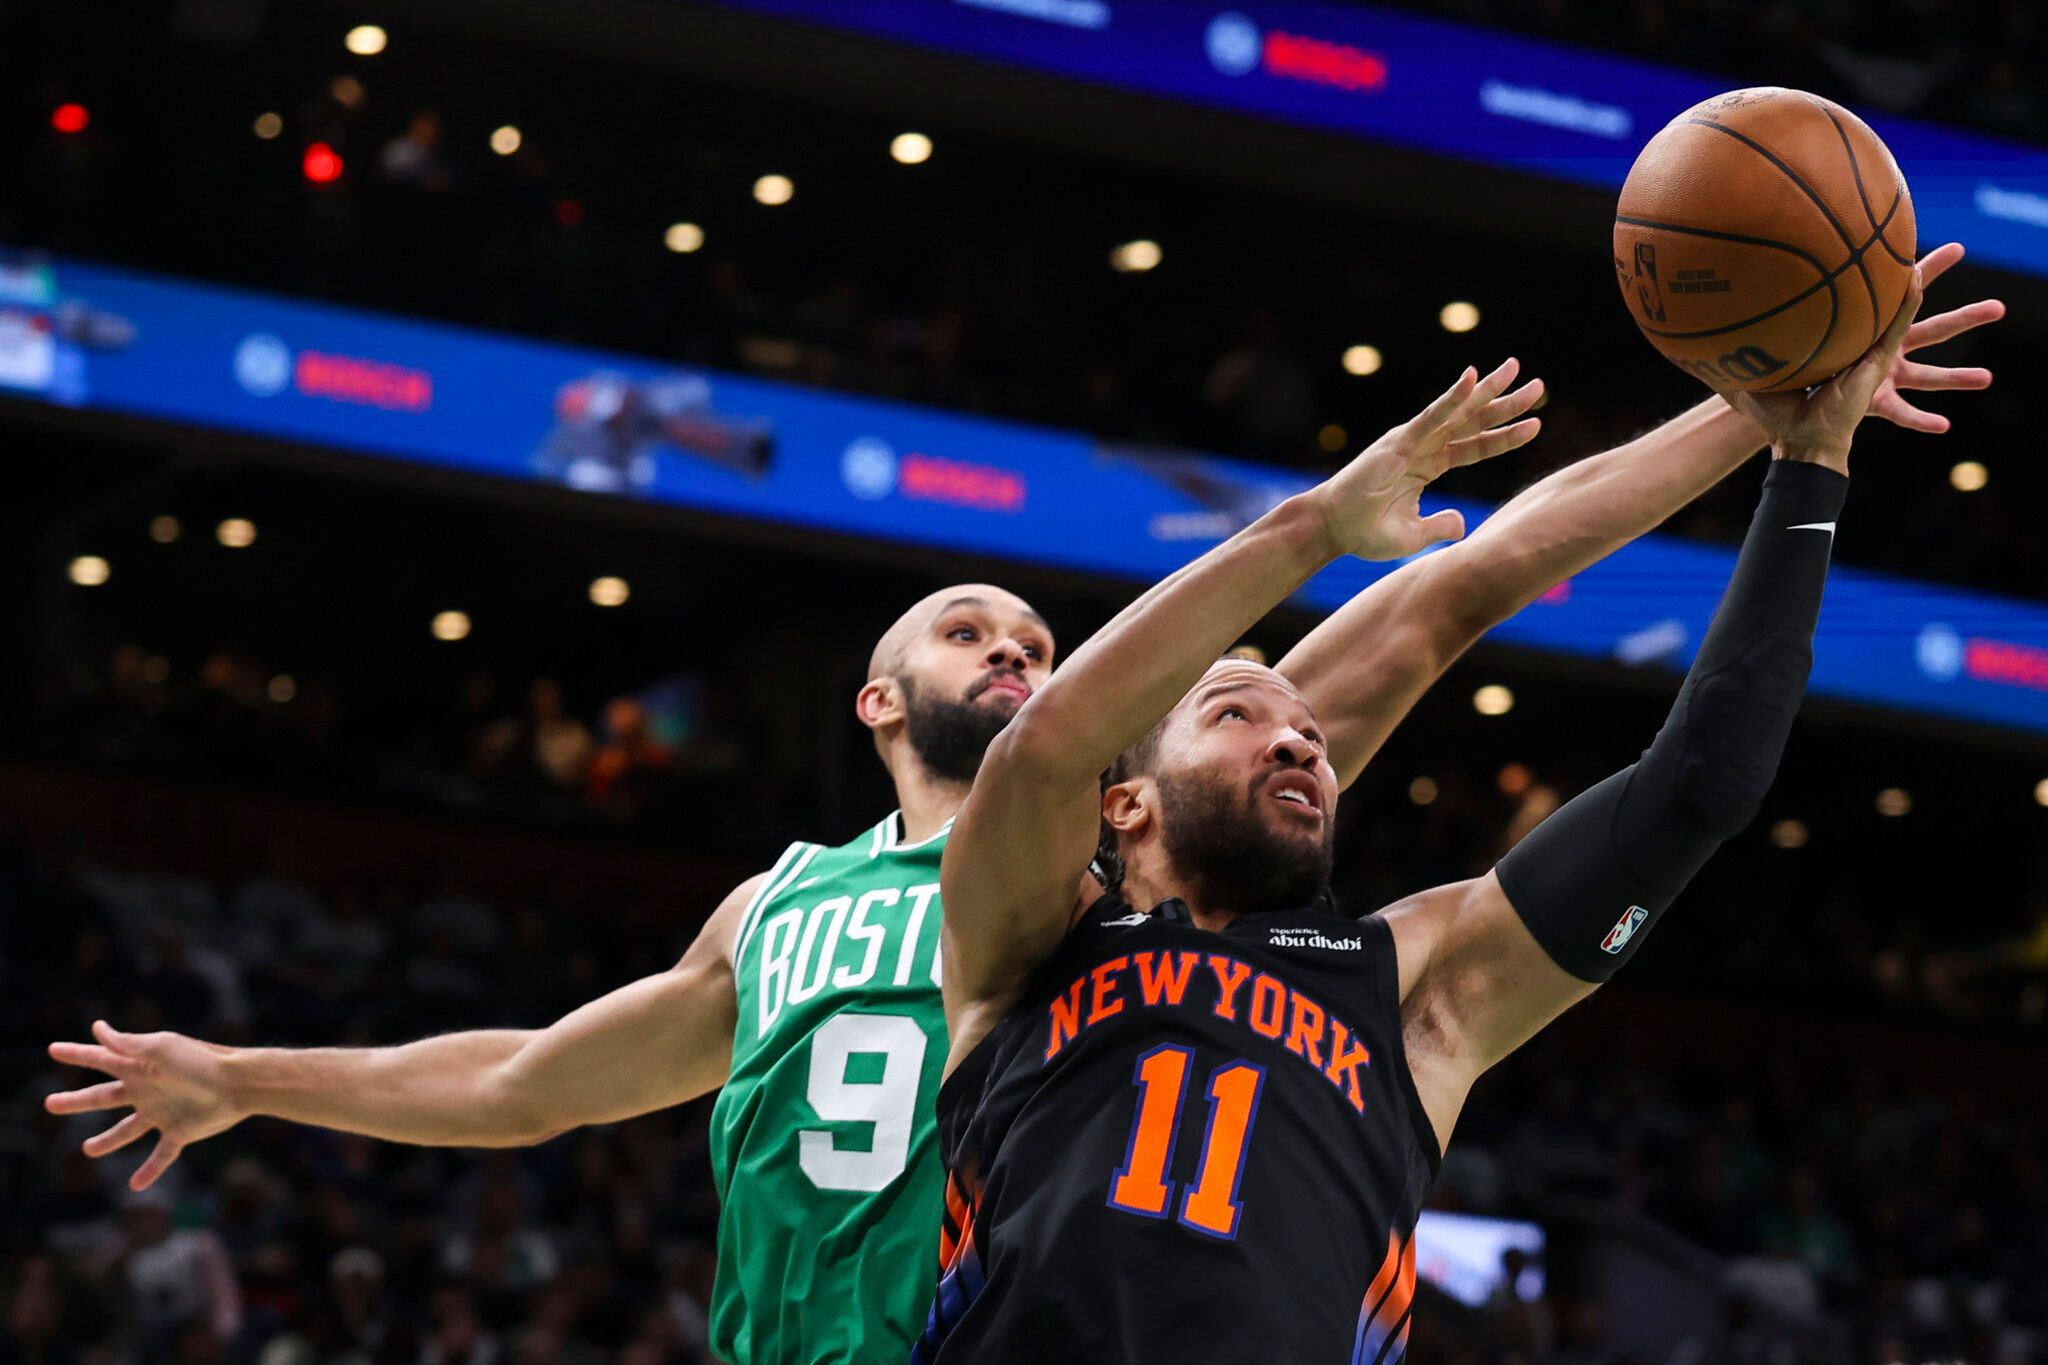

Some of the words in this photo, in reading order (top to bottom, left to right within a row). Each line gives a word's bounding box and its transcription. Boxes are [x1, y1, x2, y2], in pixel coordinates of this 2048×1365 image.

[758, 883, 943, 1040] BOST
[1269, 934, 1306, 947] abu
[1308, 935, 1362, 951] dhabi
[799, 1013, 928, 1192] 9
[1043, 951, 1200, 1066] NEW
[1206, 952, 1370, 1115] YORK
[1106, 1042, 1267, 1241] 11
